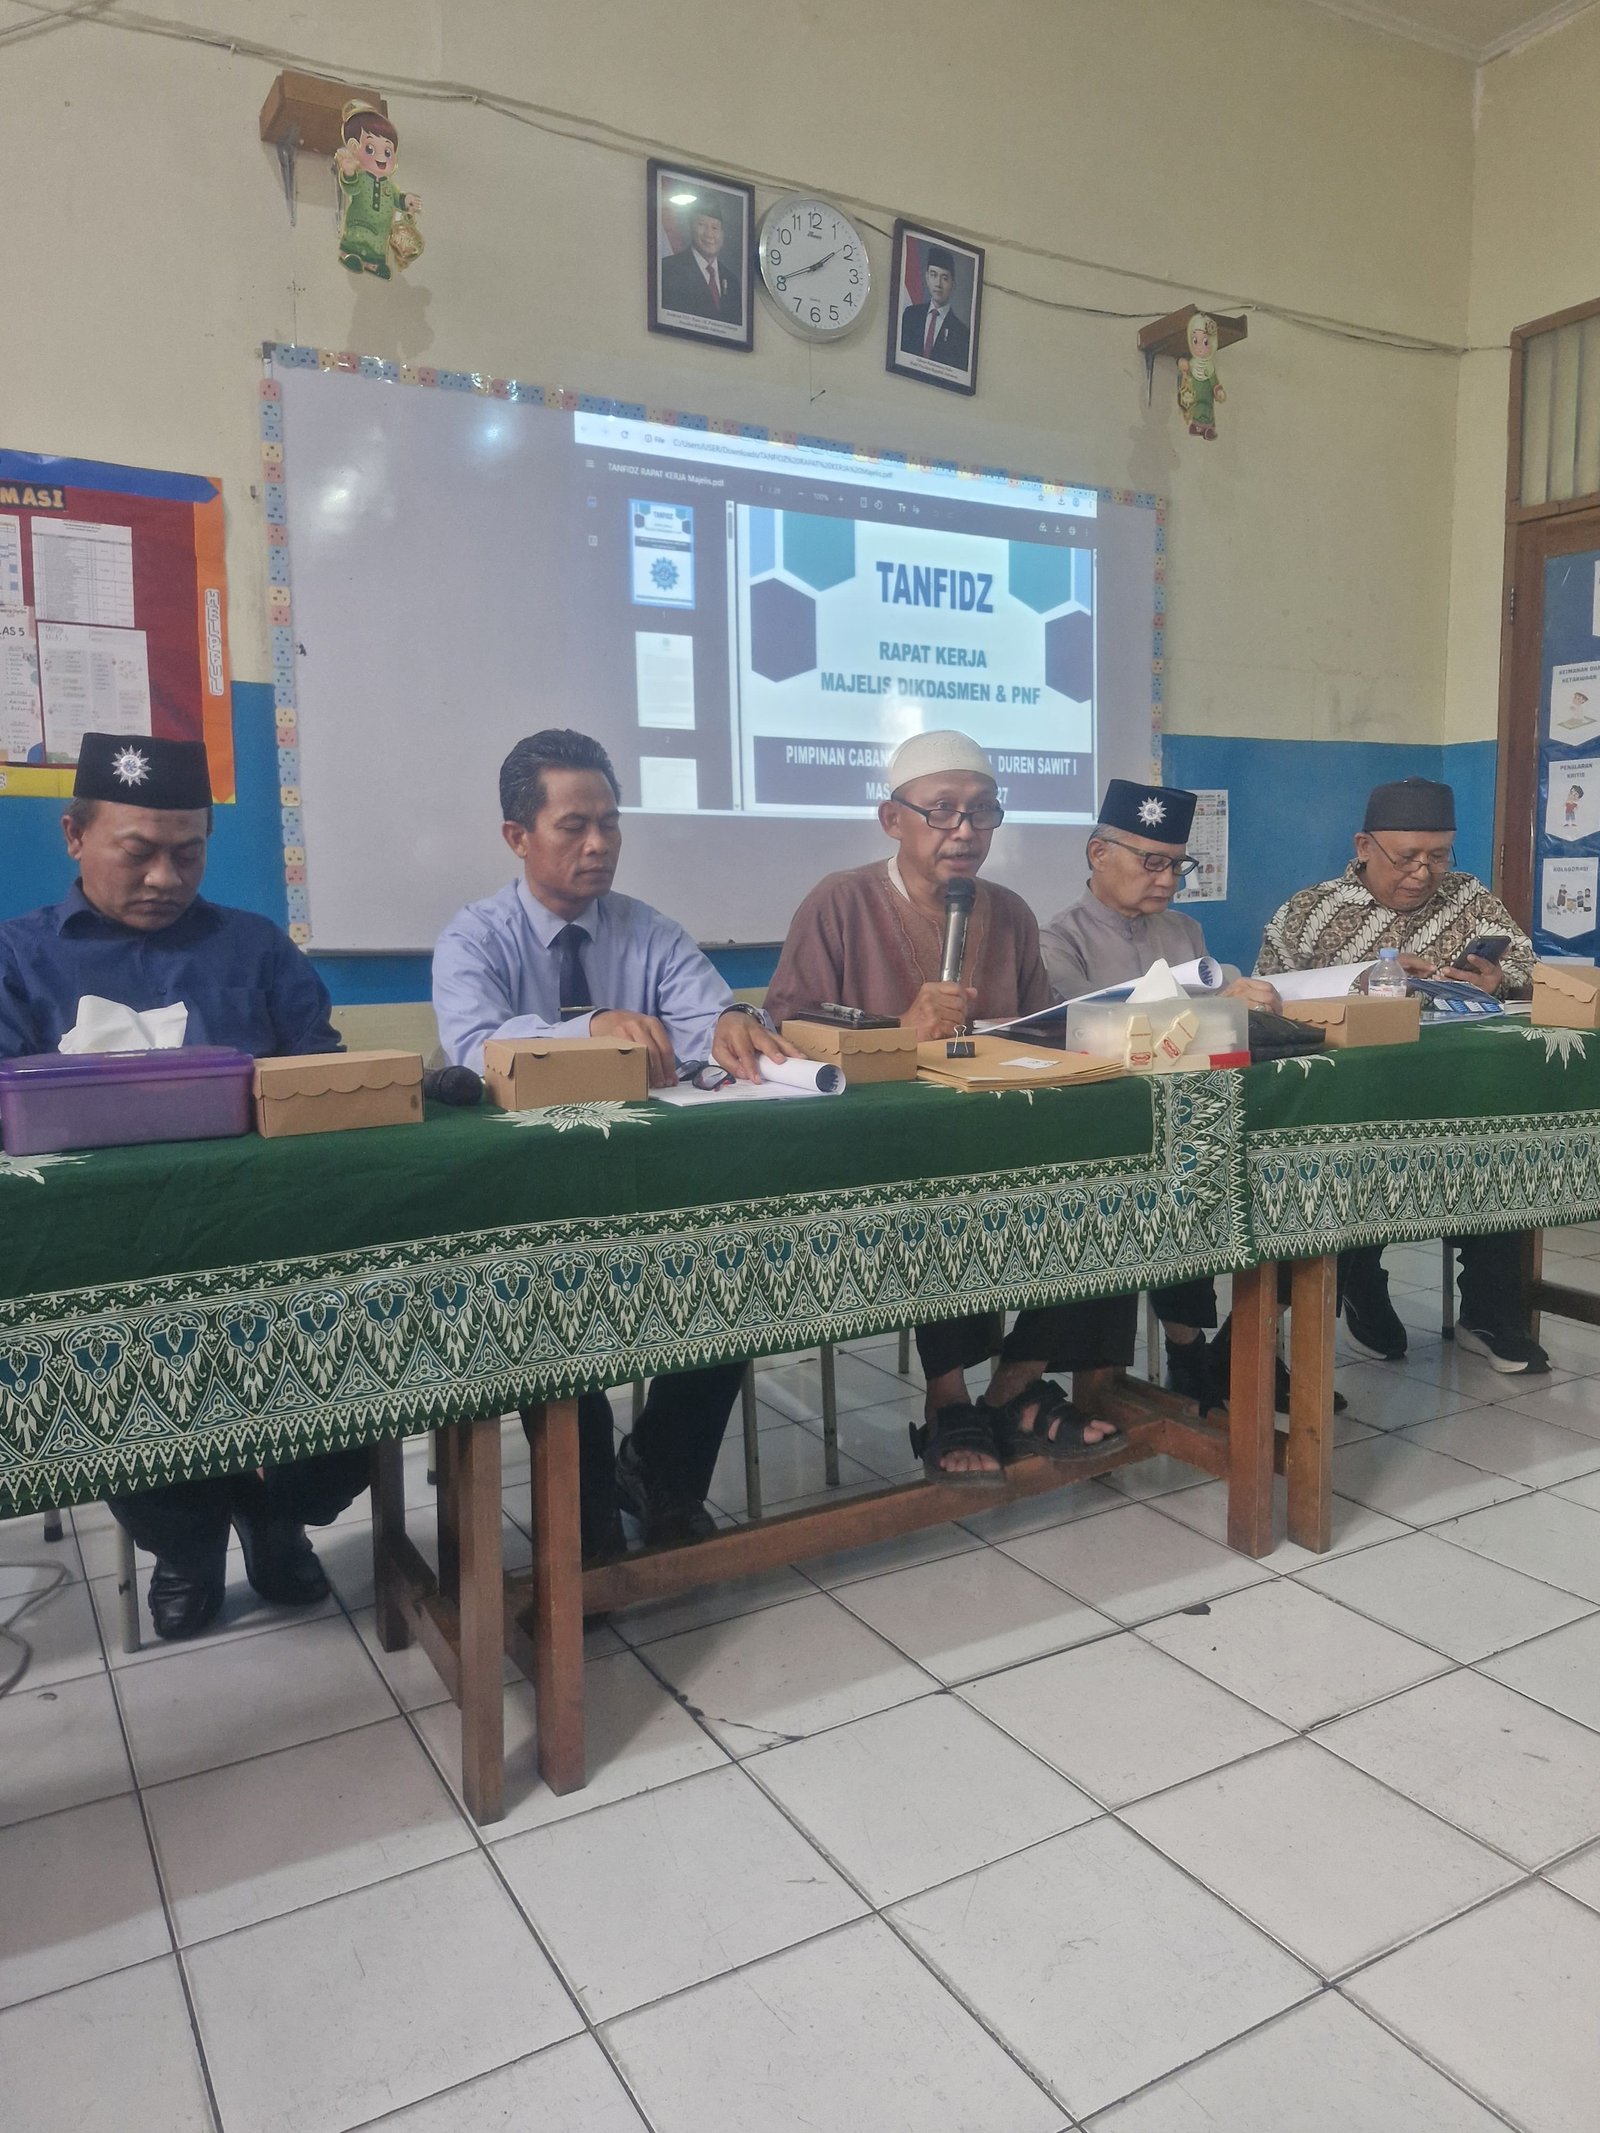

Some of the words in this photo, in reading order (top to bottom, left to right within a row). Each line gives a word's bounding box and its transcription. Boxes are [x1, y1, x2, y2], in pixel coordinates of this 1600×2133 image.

[792, 214, 801, 231] 11
[808, 211, 822, 230] 12
[776, 227, 792, 245] 10
[832, 223, 837, 240] 1
[770, 249, 781, 266] 9
[842, 244, 854, 261] 2
[776, 275, 787, 291] 8
[848, 268, 859, 285] 3
[793, 297, 803, 313] 7
[843, 292, 853, 307] 4
[809, 306, 821, 323] 6
[828, 305, 840, 321] 5
[608, 462, 640, 476] TANFIDZ
[641, 467, 664, 479] RAPAT
[665, 470, 686, 482] KERJA
[876, 560, 993, 613] TANFIDZ
[18, 626, 25, 637] 5
[879, 641, 931, 664] RAPAT
[935, 646, 988, 669] KERJA
[821, 672, 892, 695] MAJELIS
[897, 677, 991, 702] DIKDASMEN
[995, 685, 1007, 703] &
[1011, 686, 1041, 705] PNF
[785, 745, 845, 766] PIMPINAN
[998, 755, 1034, 774] DUREN
[1037, 757, 1071, 776] SAWIT
